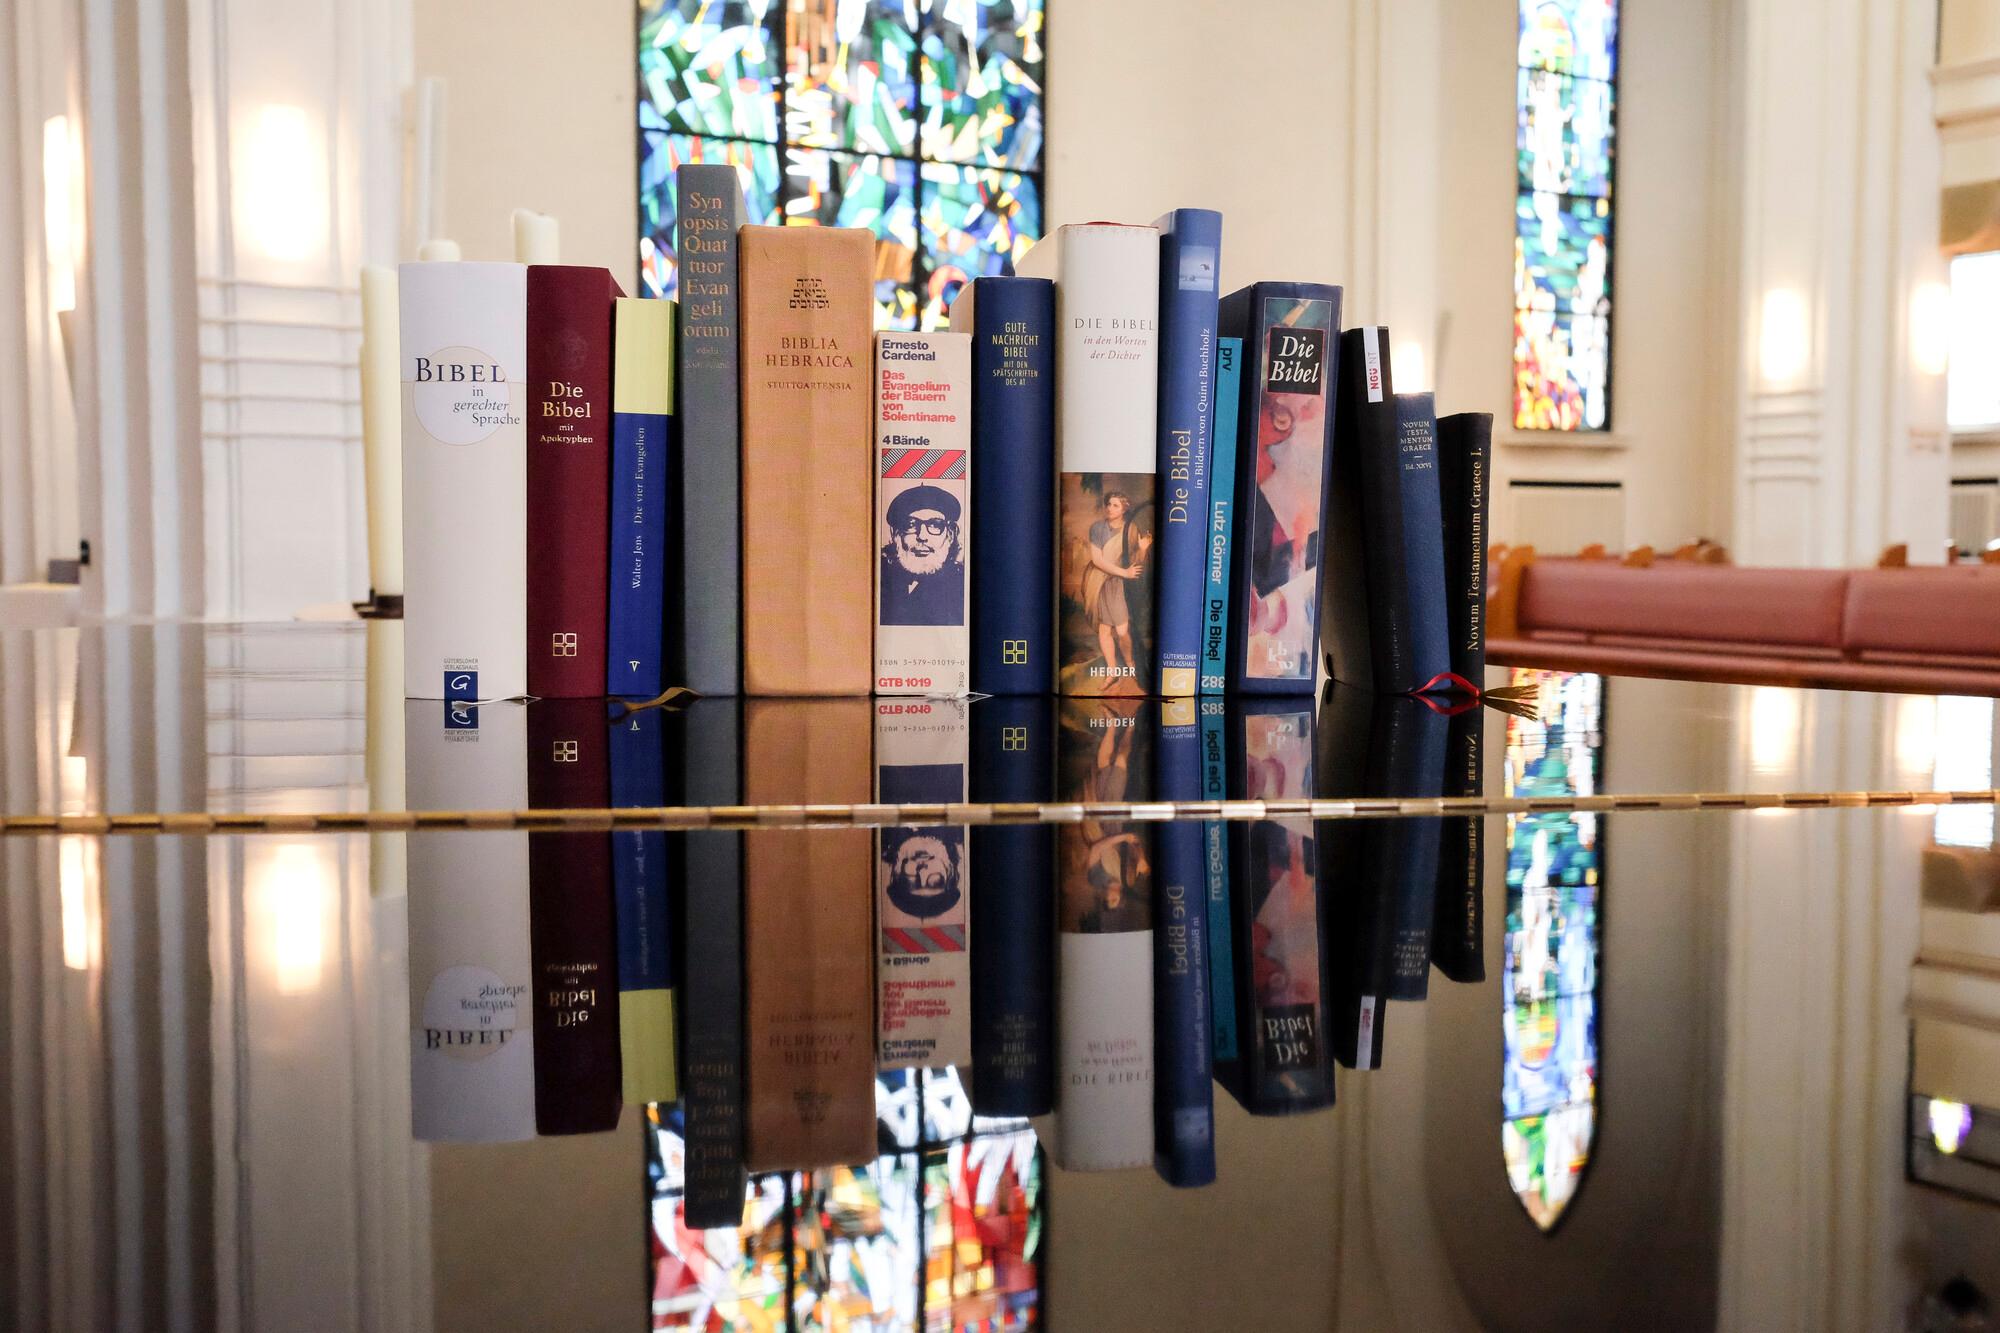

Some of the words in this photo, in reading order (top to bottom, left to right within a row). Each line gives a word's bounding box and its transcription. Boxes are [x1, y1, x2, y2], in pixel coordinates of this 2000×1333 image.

[689, 192, 722, 213] Syn
[684, 215, 729, 235] opsis
[684, 235, 727, 253] Quat
[689, 259, 725, 274] tuor
[686, 279, 729, 296] Evan
[691, 300, 722, 320] geli
[684, 324, 730, 337] orum
[1005, 322, 1026, 333] GUTE
[1075, 318, 1102, 329] DIE
[1112, 319, 1155, 331] BIBEL
[782, 337, 838, 350] BIBLIA
[882, 340, 929, 350] Ernesto
[992, 334, 1038, 345] NACHRICHT
[1084, 336, 1092, 345] in
[1095, 336, 1111, 345] den
[1115, 336, 1147, 346] Worten
[1280, 335, 1314, 359] Die
[882, 350, 936, 361] Cardenal
[1004, 347, 1028, 358] BIBEL
[1090, 351, 1104, 359] der
[1108, 351, 1141, 360] Dichter
[1200, 328, 1210, 378] Buchholz
[1219, 347, 1232, 371] prv
[1368, 351, 1377, 364] NT
[766, 355, 853, 368] HEBRAICA
[415, 358, 506, 382] BIBEL
[882, 370, 905, 380] Das
[992, 368, 1038, 378] SPÄTSCHRIFTEN
[1269, 361, 1320, 384] Bibel
[767, 382, 851, 390] STUTTGARTENSIA
[1370, 367, 1379, 390] NGÜ
[472, 386, 483, 397] in
[550, 382, 583, 398] Die
[882, 381, 950, 393] Evangelium
[882, 391, 902, 400] der
[904, 391, 946, 401] Bauern
[1198, 381, 1208, 412] Quint
[453, 399, 509, 412] gerechter
[542, 402, 591, 418] Bibel
[472, 413, 520, 426] Sprache
[882, 412, 956, 423] Solentiname
[540, 435, 593, 444] Apokryphen
[883, 436, 890, 445] 4
[892, 435, 930, 446] Bände
[1400, 436, 1432, 444] MENTUM
[635, 427, 647, 480] Evangelien
[1171, 430, 1190, 480] Bibel
[1195, 438, 1204, 477] Bildern
[1195, 480, 1202, 489] in
[1471, 462, 1482, 508] Graece
[1169, 488, 1188, 524] Die
[634, 506, 643, 524] Die
[1214, 502, 1227, 531] Lutz
[634, 535, 643, 555] Jens
[1212, 535, 1226, 584] Görner
[1468, 513, 1480, 599] Testamentum
[632, 556, 642, 588] Walter
[1210, 600, 1223, 622] Die
[1468, 603, 1479, 651] Novum
[1206, 626, 1221, 660] Bibel
[1090, 667, 1136, 677] HERDER
[879, 678, 903, 687] GTB
[905, 678, 931, 687] 1019
